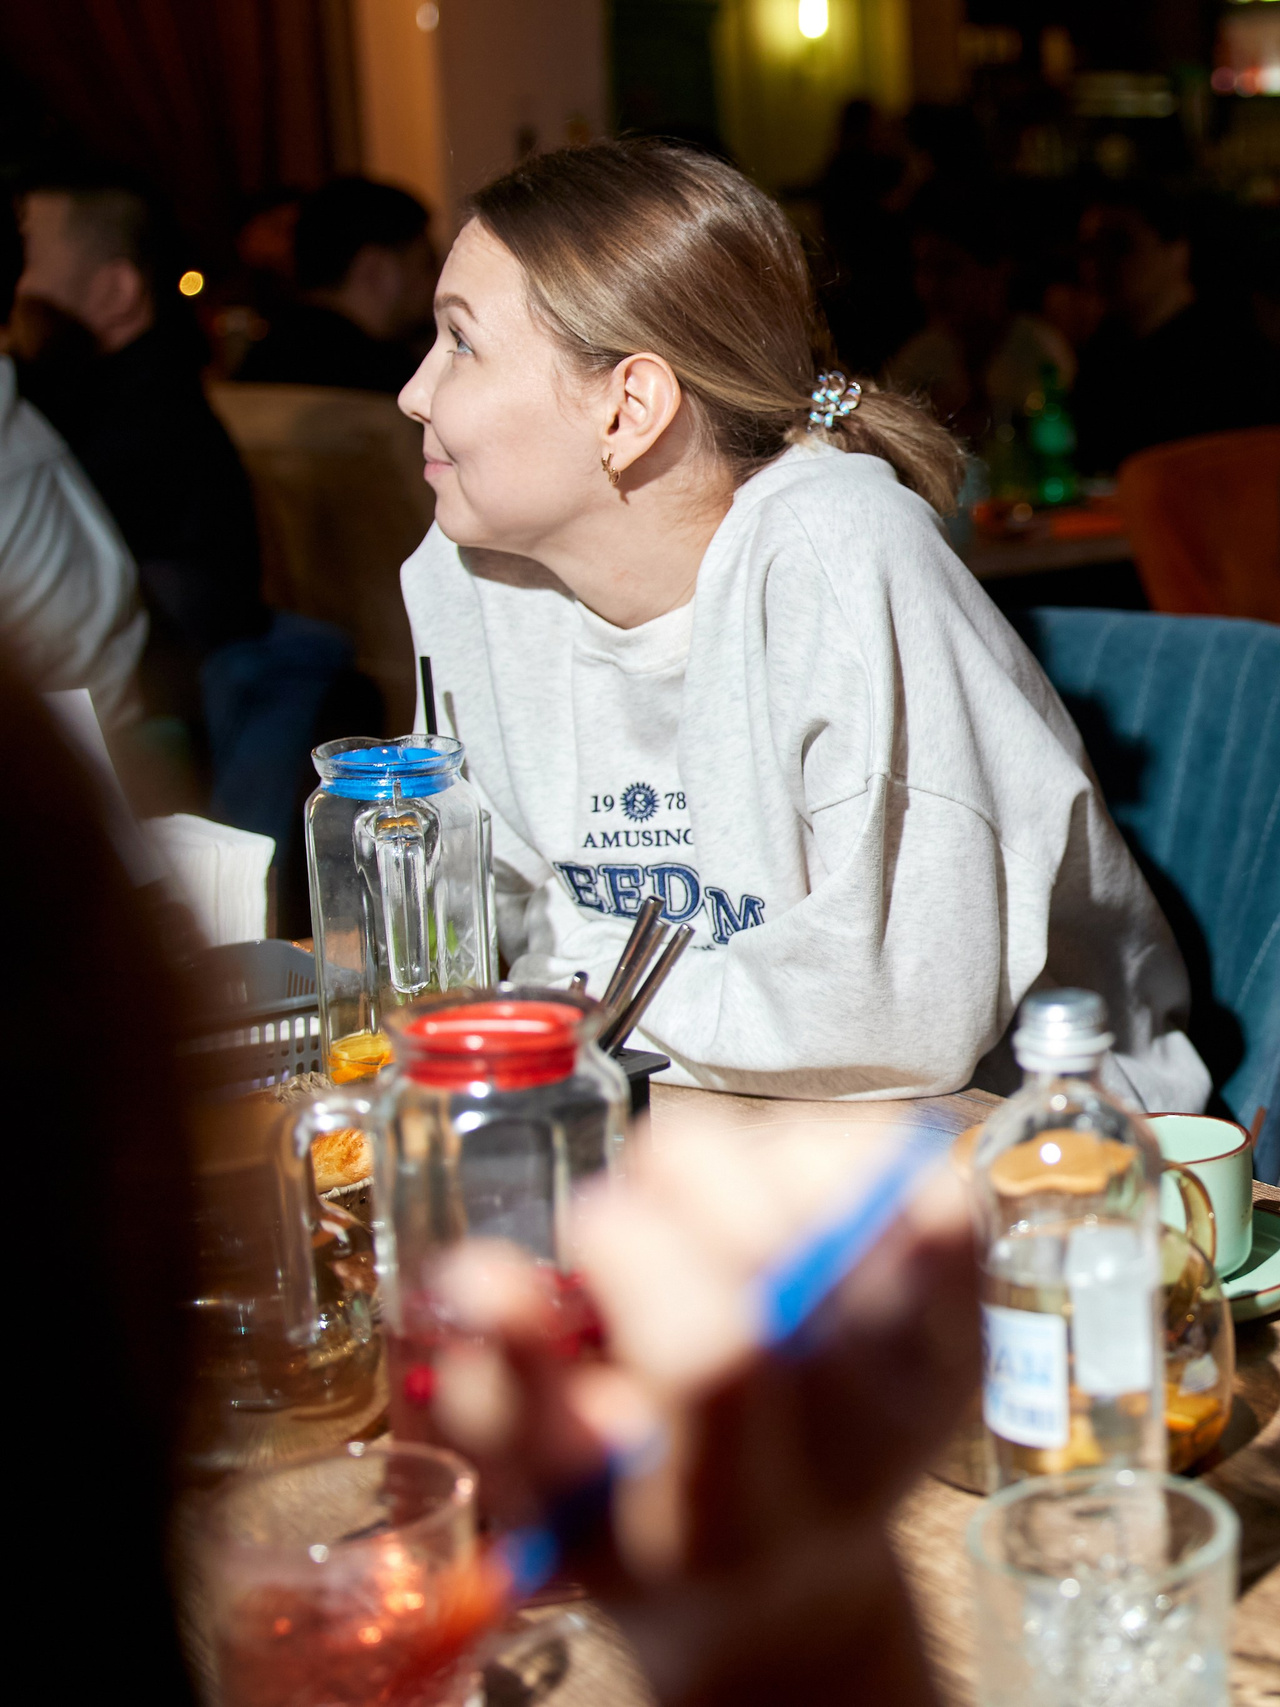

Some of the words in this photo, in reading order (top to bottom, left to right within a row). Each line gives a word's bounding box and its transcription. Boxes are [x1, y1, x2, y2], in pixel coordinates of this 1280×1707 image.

[590, 794, 615, 813] 19
[664, 791, 687, 810] 78
[552, 861, 765, 945] EEDM
